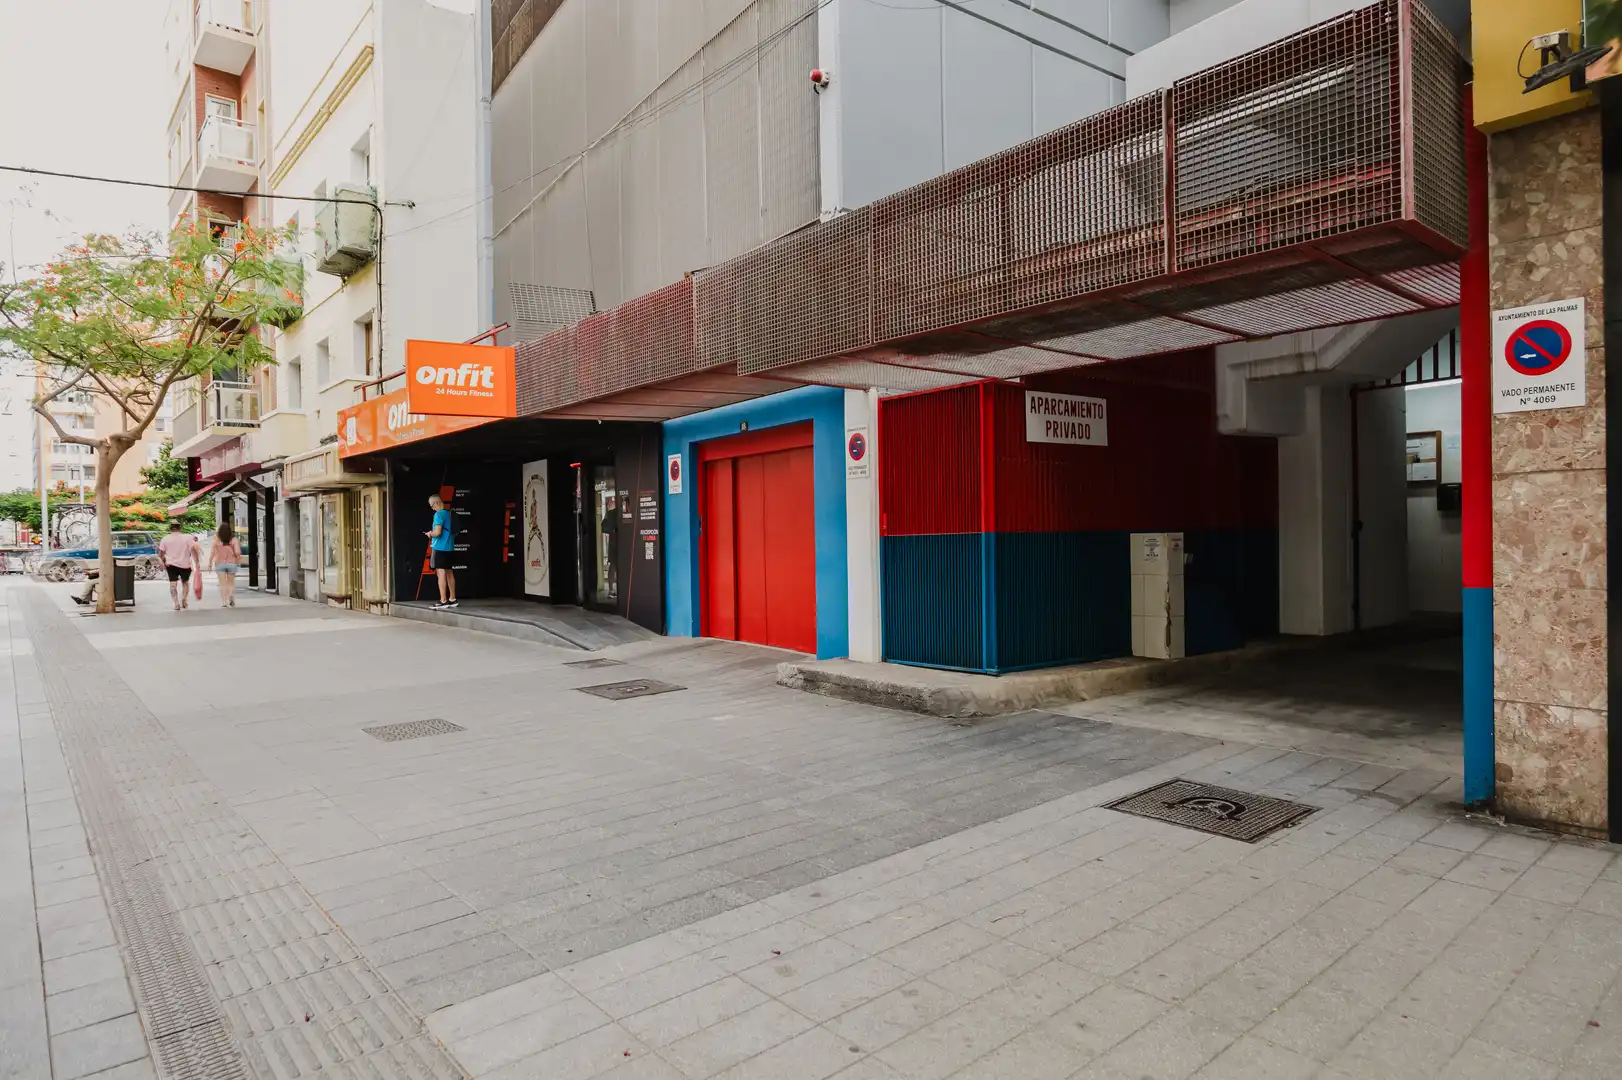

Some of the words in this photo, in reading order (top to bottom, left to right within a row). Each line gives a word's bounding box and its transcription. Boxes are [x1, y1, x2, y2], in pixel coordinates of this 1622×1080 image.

[1498, 311, 1537, 321] AYUNTAMIENTO
[1556, 304, 1578, 312] PALMAS
[415, 362, 494, 389] onfit
[435, 387, 445, 395] 24
[446, 388, 468, 396] Hours
[469, 389, 494, 397] Fitness
[1501, 388, 1522, 397] VADO
[1523, 383, 1576, 395] PERMANENTE
[1030, 396, 1104, 419] APARCAMIENTO
[1533, 395, 1556, 404] 4069
[1045, 419, 1091, 440] PRIVADO
